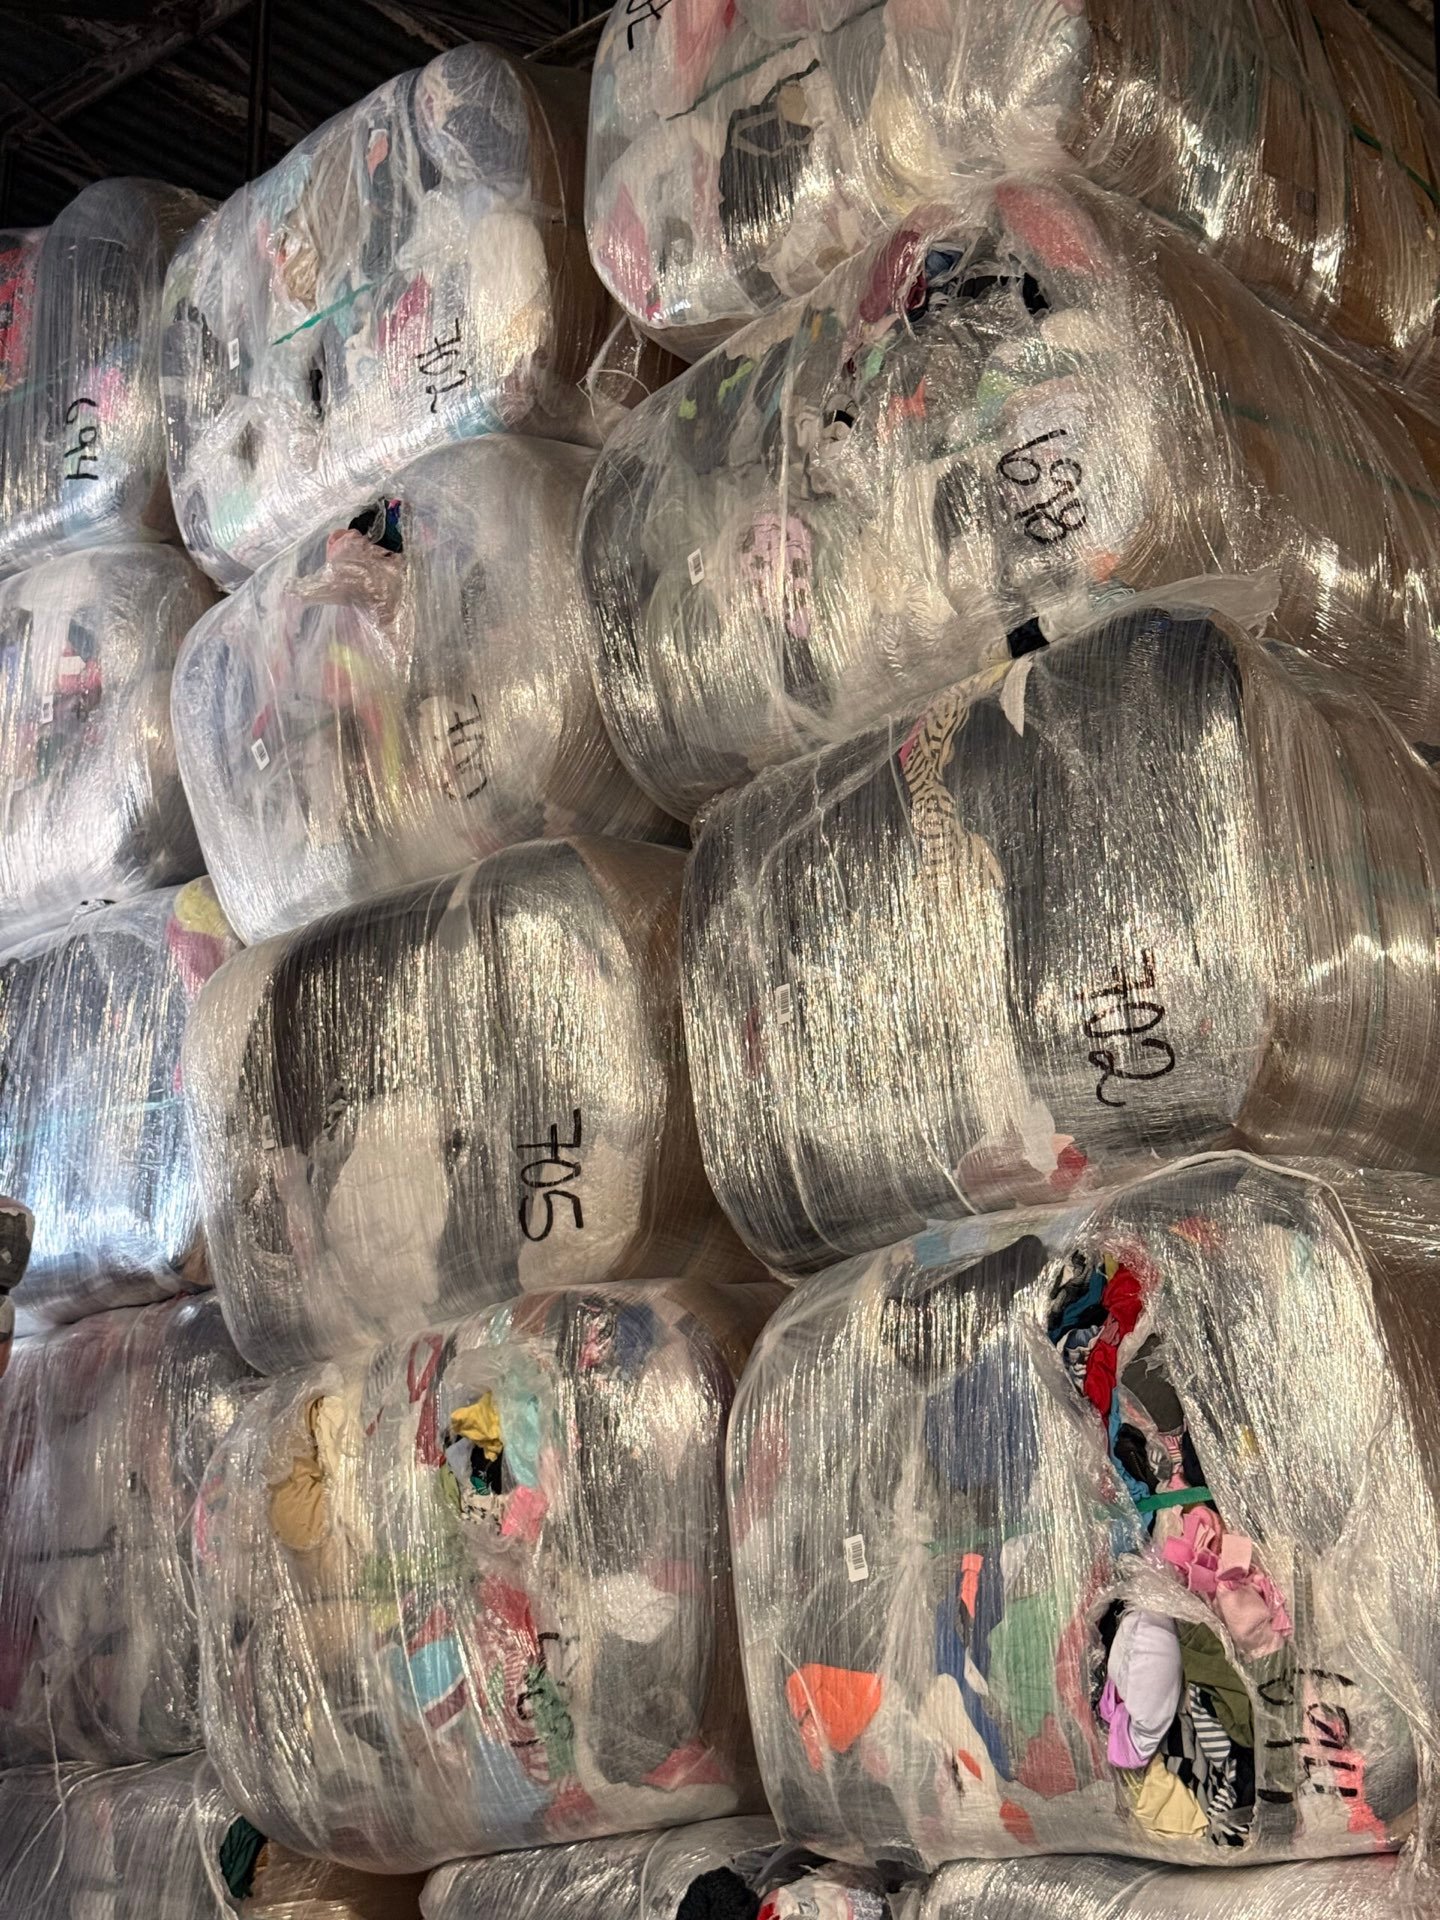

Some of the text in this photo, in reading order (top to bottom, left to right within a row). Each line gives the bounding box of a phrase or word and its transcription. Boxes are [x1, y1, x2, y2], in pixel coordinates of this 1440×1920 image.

[415, 318, 467, 414] 702
[64, 396, 99, 481] 694
[1076, 947, 1177, 1108] 702
[516, 1108, 585, 1243] 705
